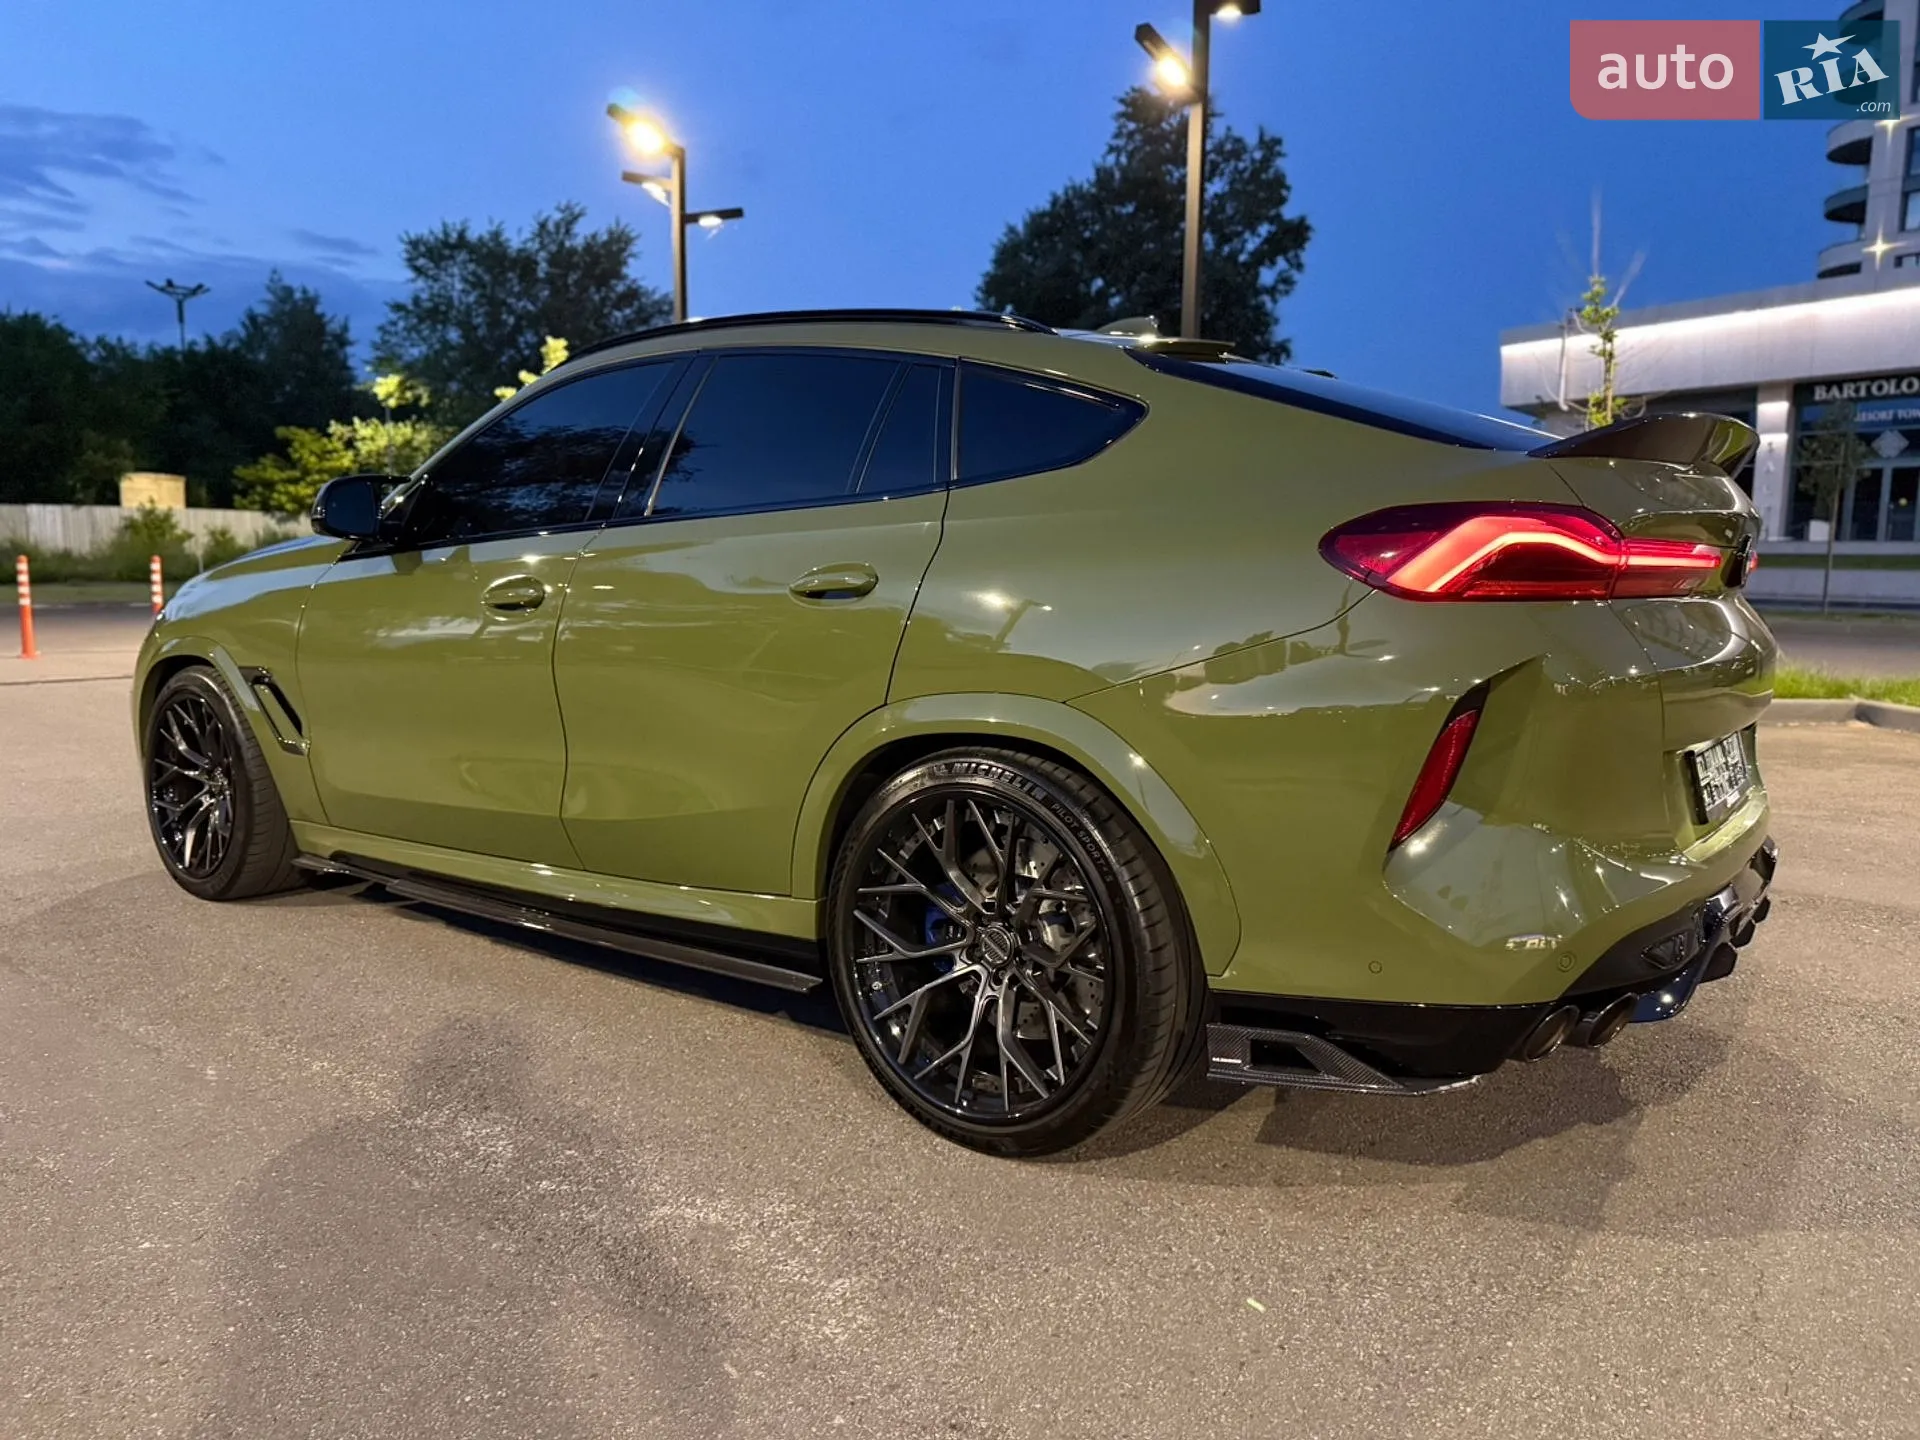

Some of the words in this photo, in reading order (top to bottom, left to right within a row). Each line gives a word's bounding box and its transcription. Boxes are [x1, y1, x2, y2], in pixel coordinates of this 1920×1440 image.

[1813, 376, 1920, 401] BARTOLO
[952, 762, 1047, 801] MICHELIN
[1051, 802, 1080, 830] PILOT
[1077, 829, 1107, 867] SPORT
